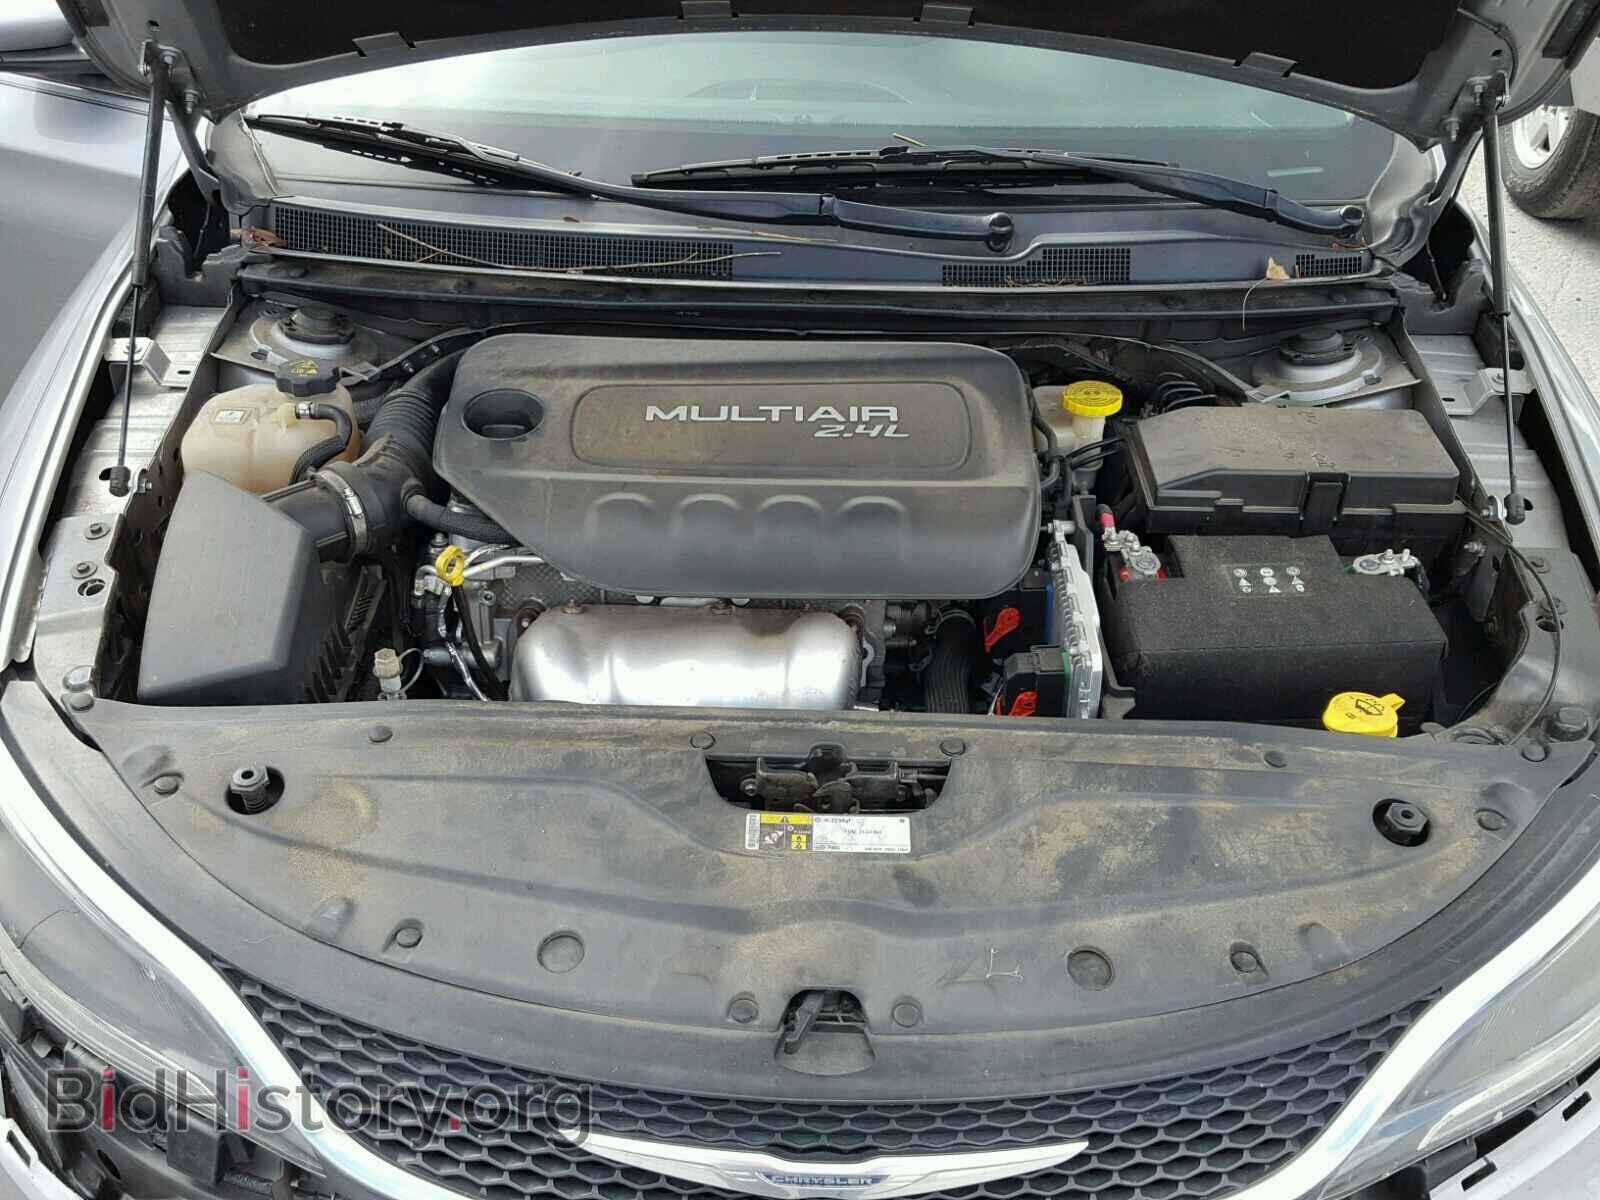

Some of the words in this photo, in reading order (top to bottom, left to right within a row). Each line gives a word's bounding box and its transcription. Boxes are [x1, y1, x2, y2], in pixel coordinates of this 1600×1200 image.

[645, 405, 899, 422] MULTIAIR
[813, 424, 910, 438] 2.4L
[770, 1174, 874, 1186] CHRYSLER
